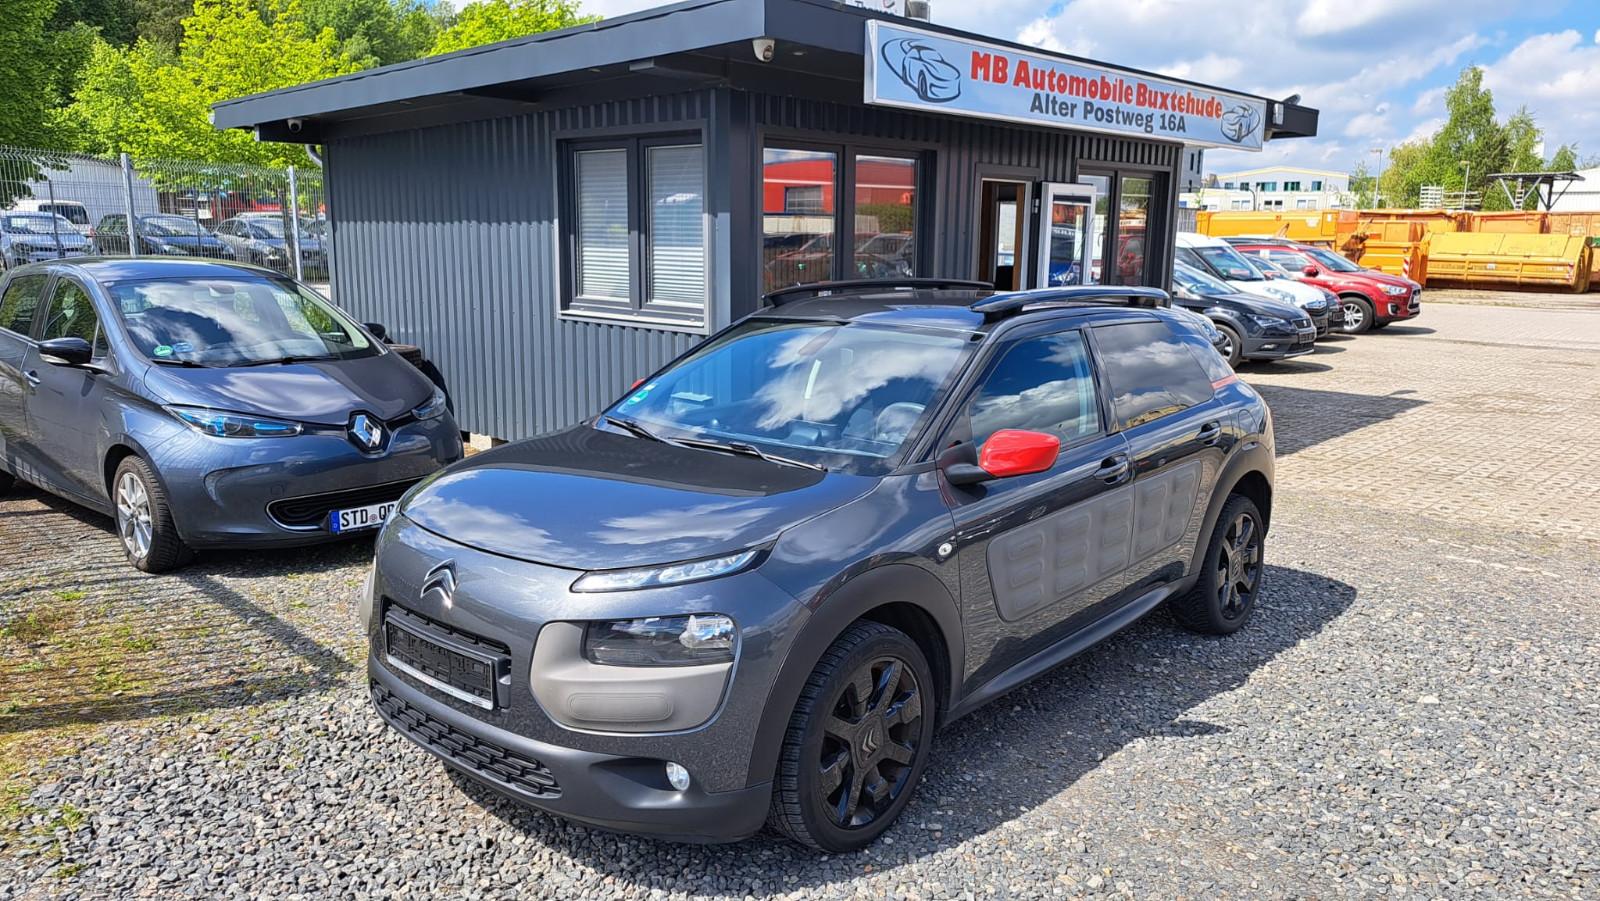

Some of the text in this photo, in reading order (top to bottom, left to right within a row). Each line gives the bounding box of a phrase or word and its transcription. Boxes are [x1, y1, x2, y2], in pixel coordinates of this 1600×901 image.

[971, 51, 1222, 119] MB Automobile Buxtehude
[1030, 93, 1186, 133] Alter Postweg 16A
[341, 509, 369, 528] STD
